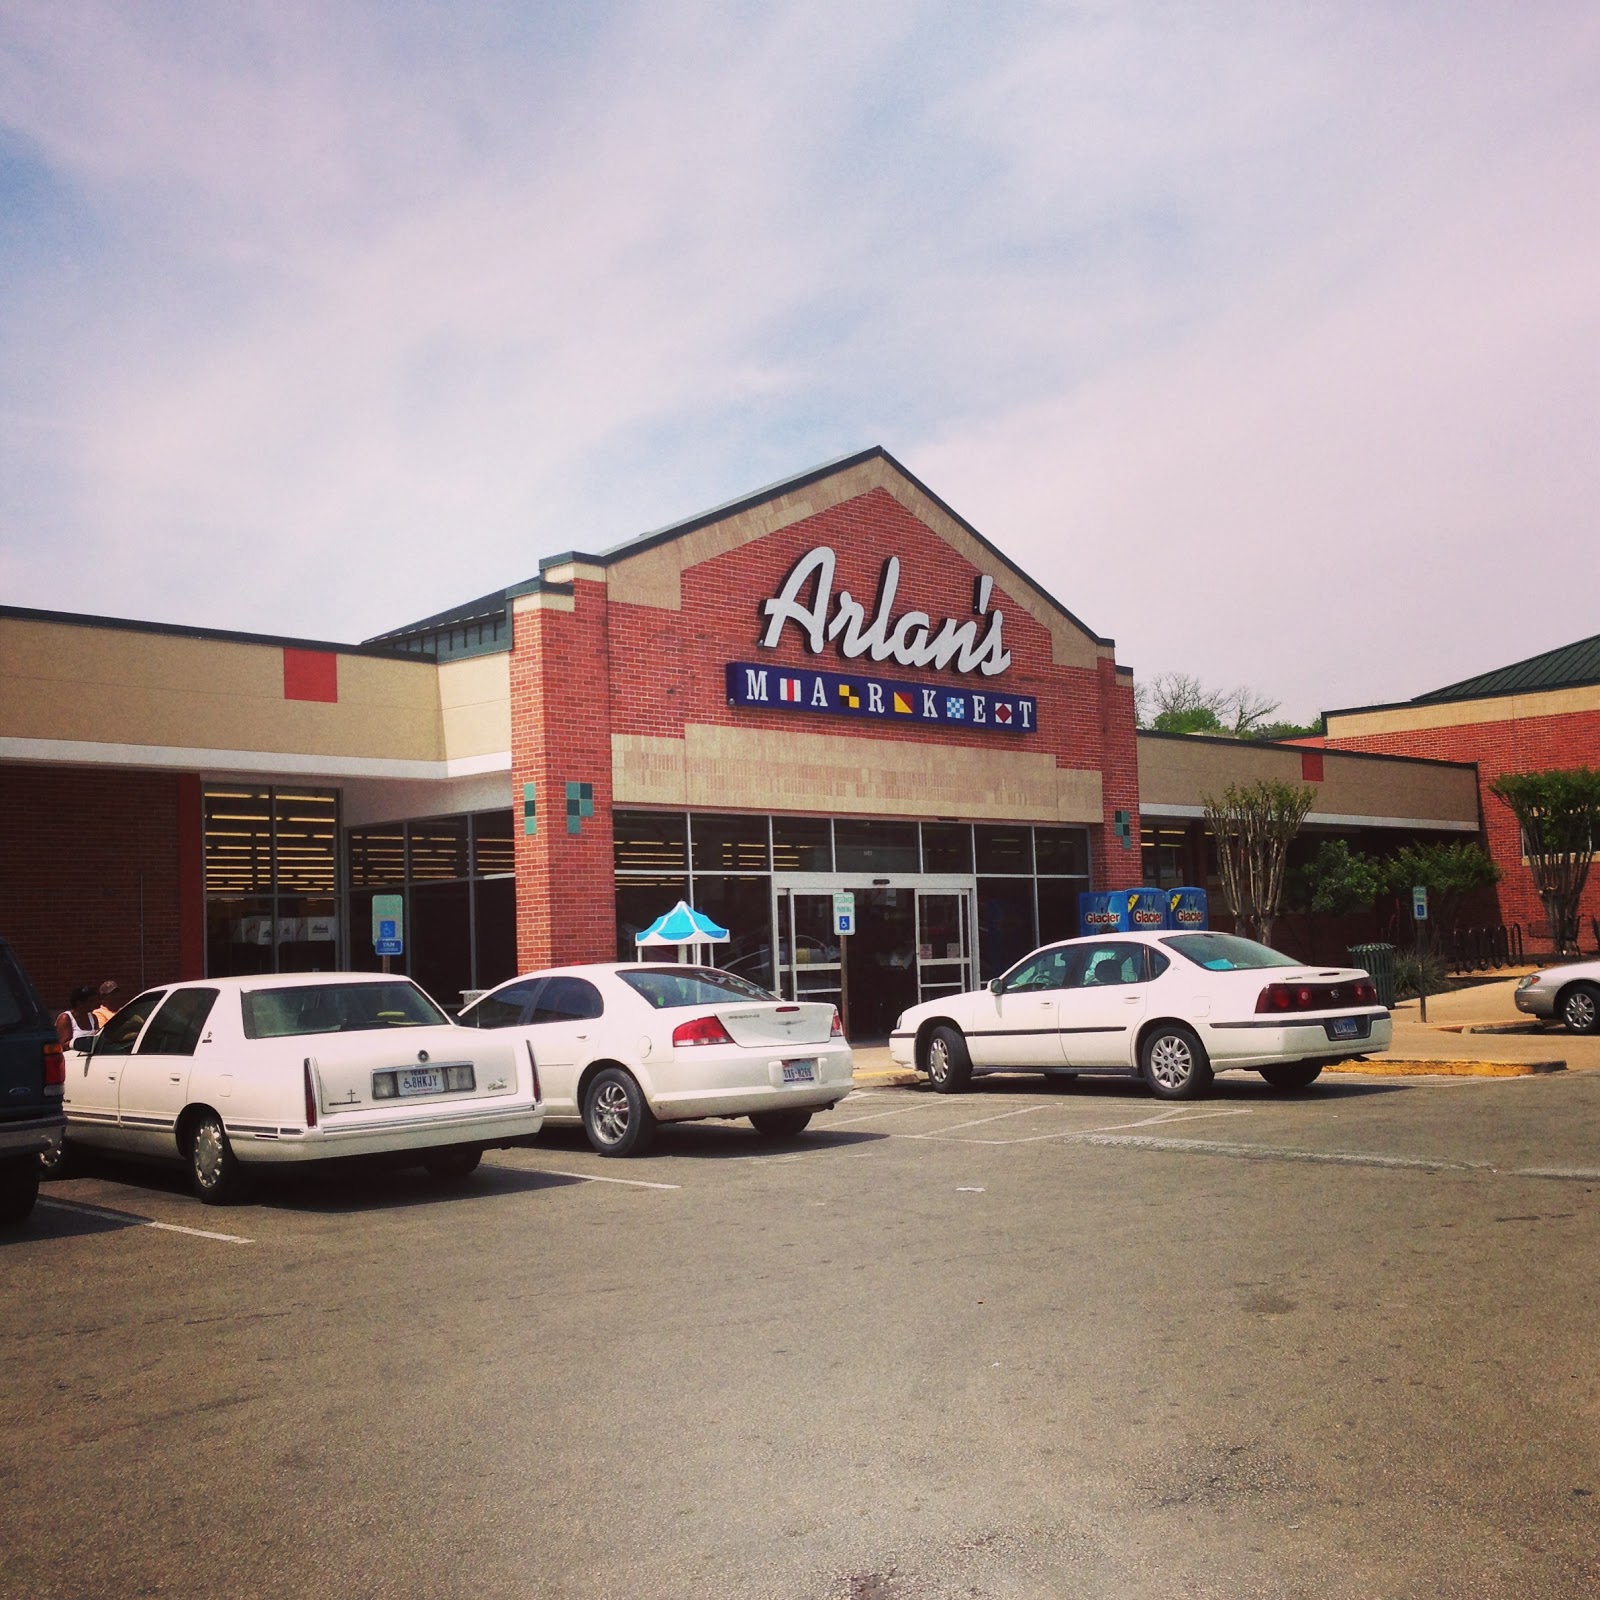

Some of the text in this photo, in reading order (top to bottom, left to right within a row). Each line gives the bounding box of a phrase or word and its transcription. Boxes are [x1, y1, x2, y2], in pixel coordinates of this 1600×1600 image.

[763, 546, 1011, 676] Arlan's
[745, 668, 1033, 728] MARKET
[1085, 911, 1121, 925] Glacier
[1134, 910, 1163, 924] Glacier
[1176, 909, 1204, 923] Glacier
[410, 1068, 429, 1076] TEXAS
